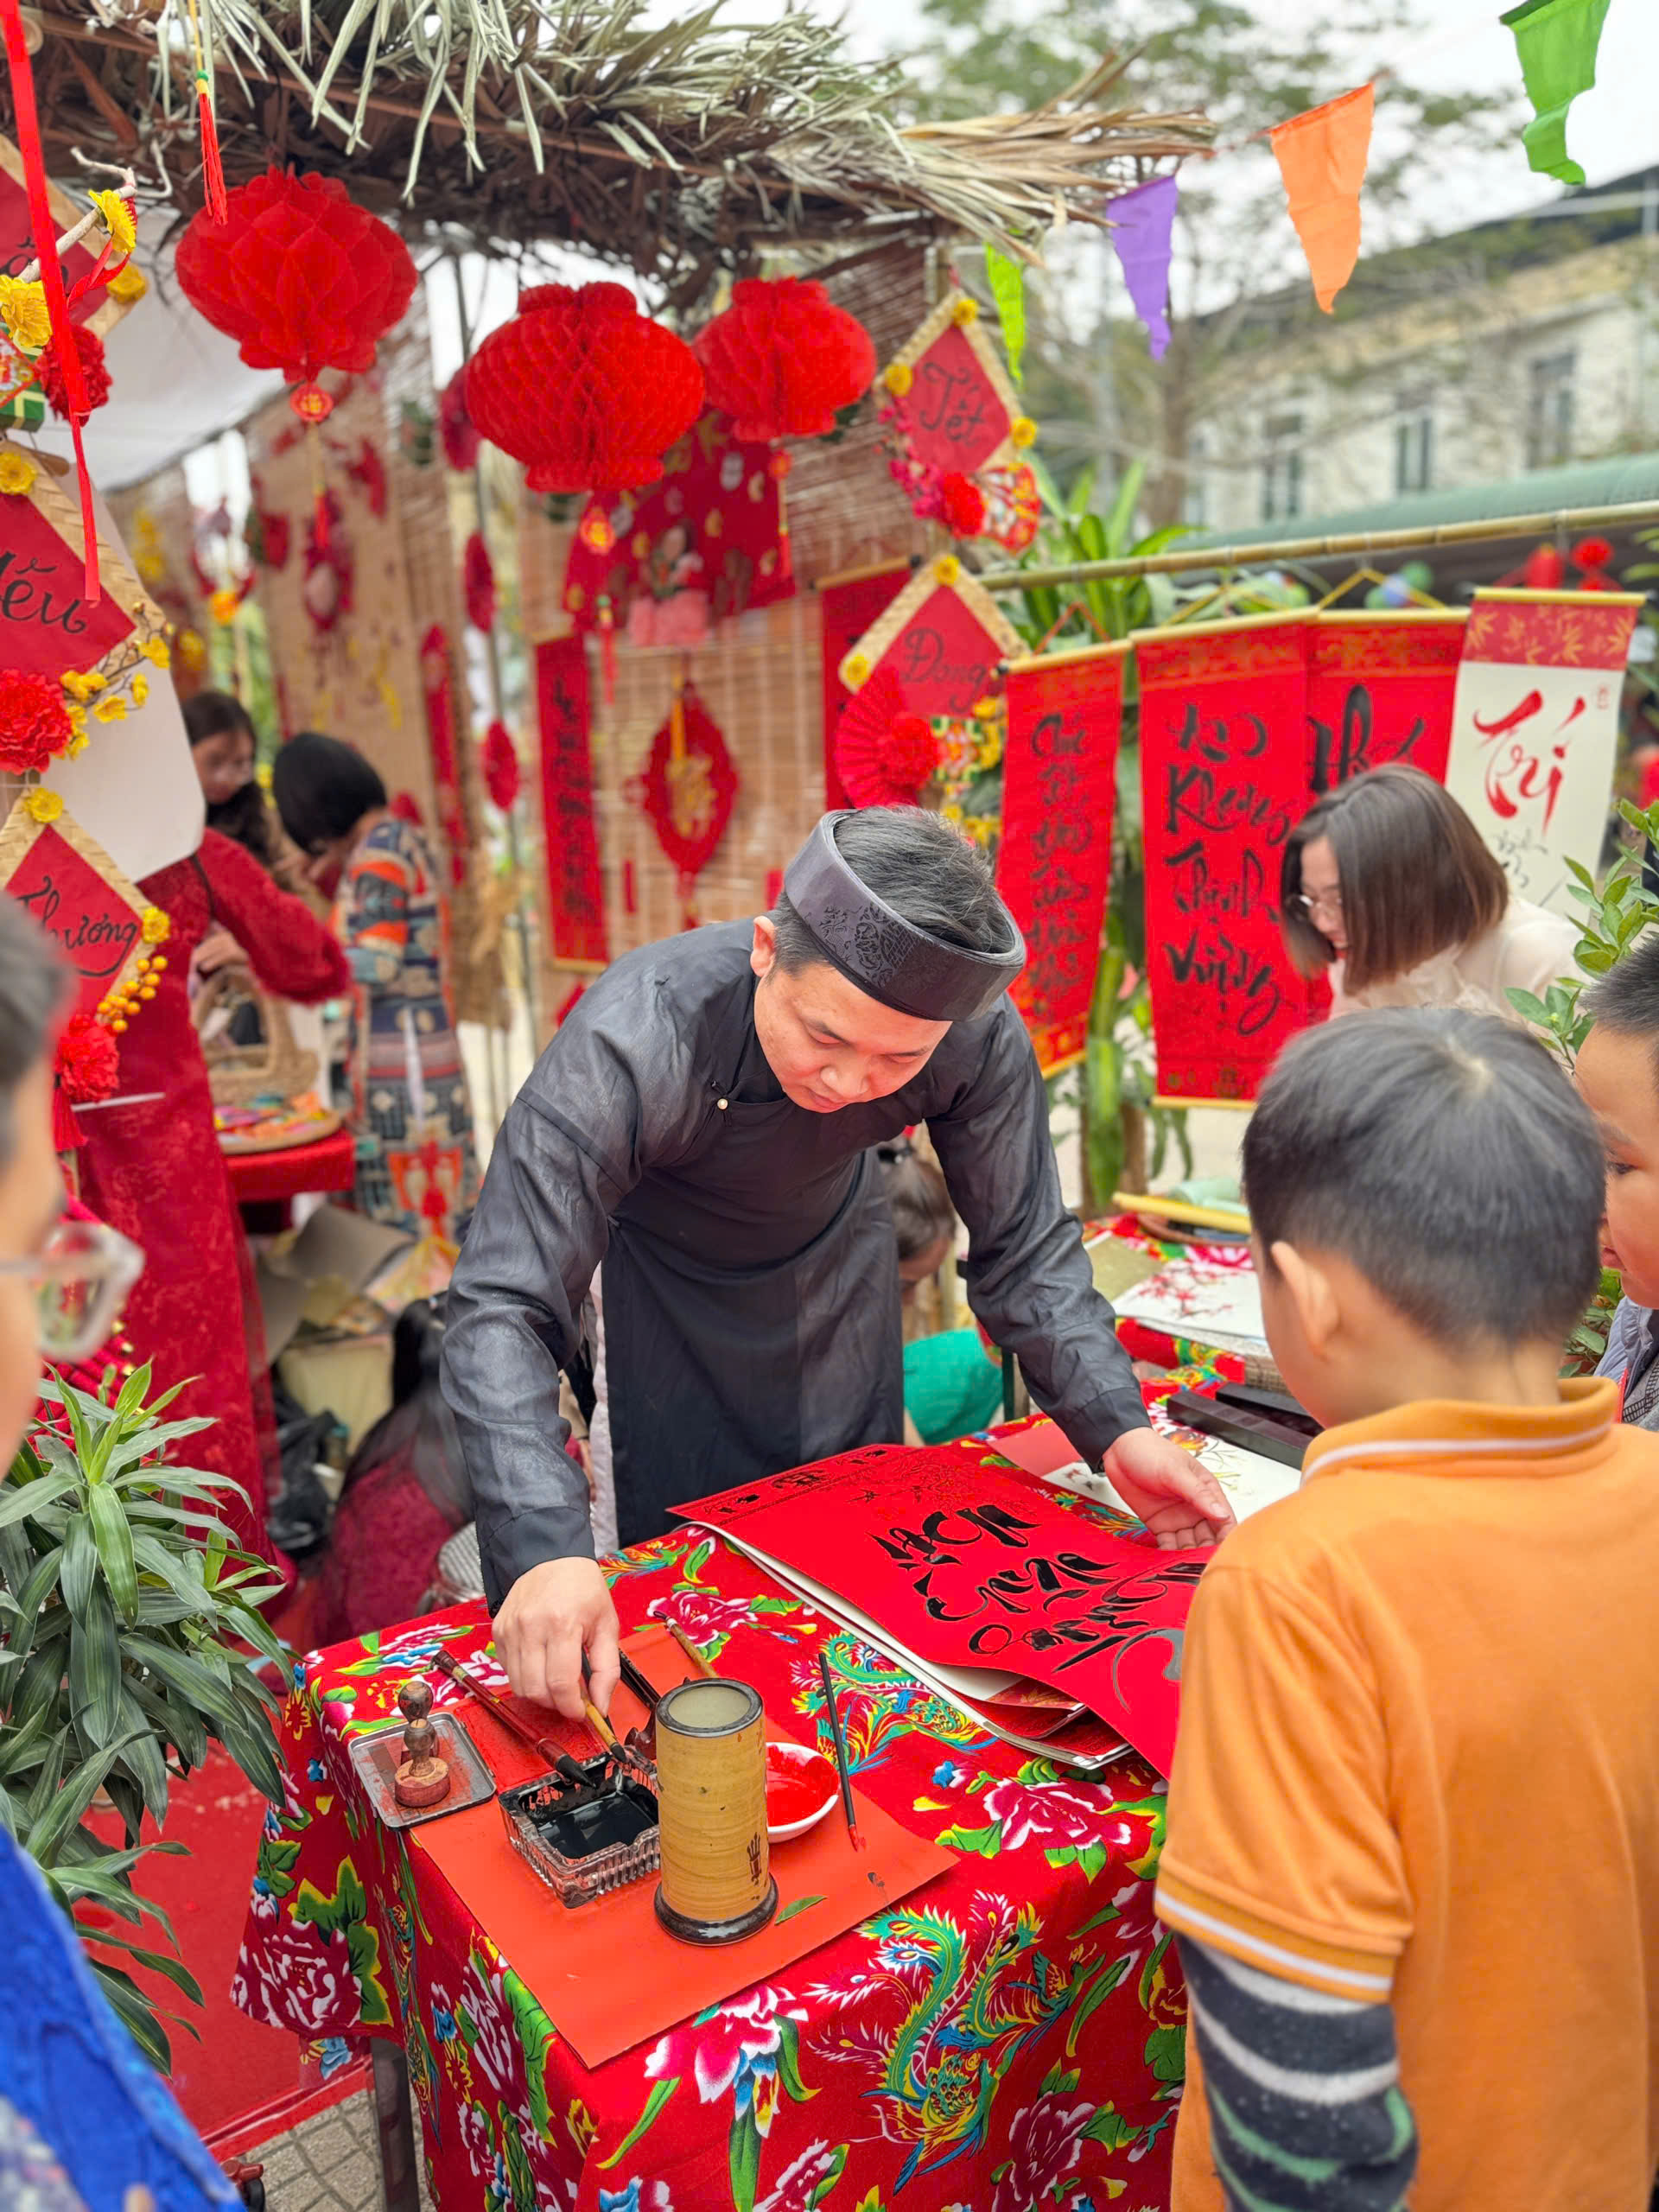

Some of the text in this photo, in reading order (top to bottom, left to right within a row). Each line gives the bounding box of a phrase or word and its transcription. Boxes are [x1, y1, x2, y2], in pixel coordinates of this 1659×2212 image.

[918, 361, 985, 448] Tết
[0, 550, 87, 634] êu
[1472, 688, 1586, 836] Trí
